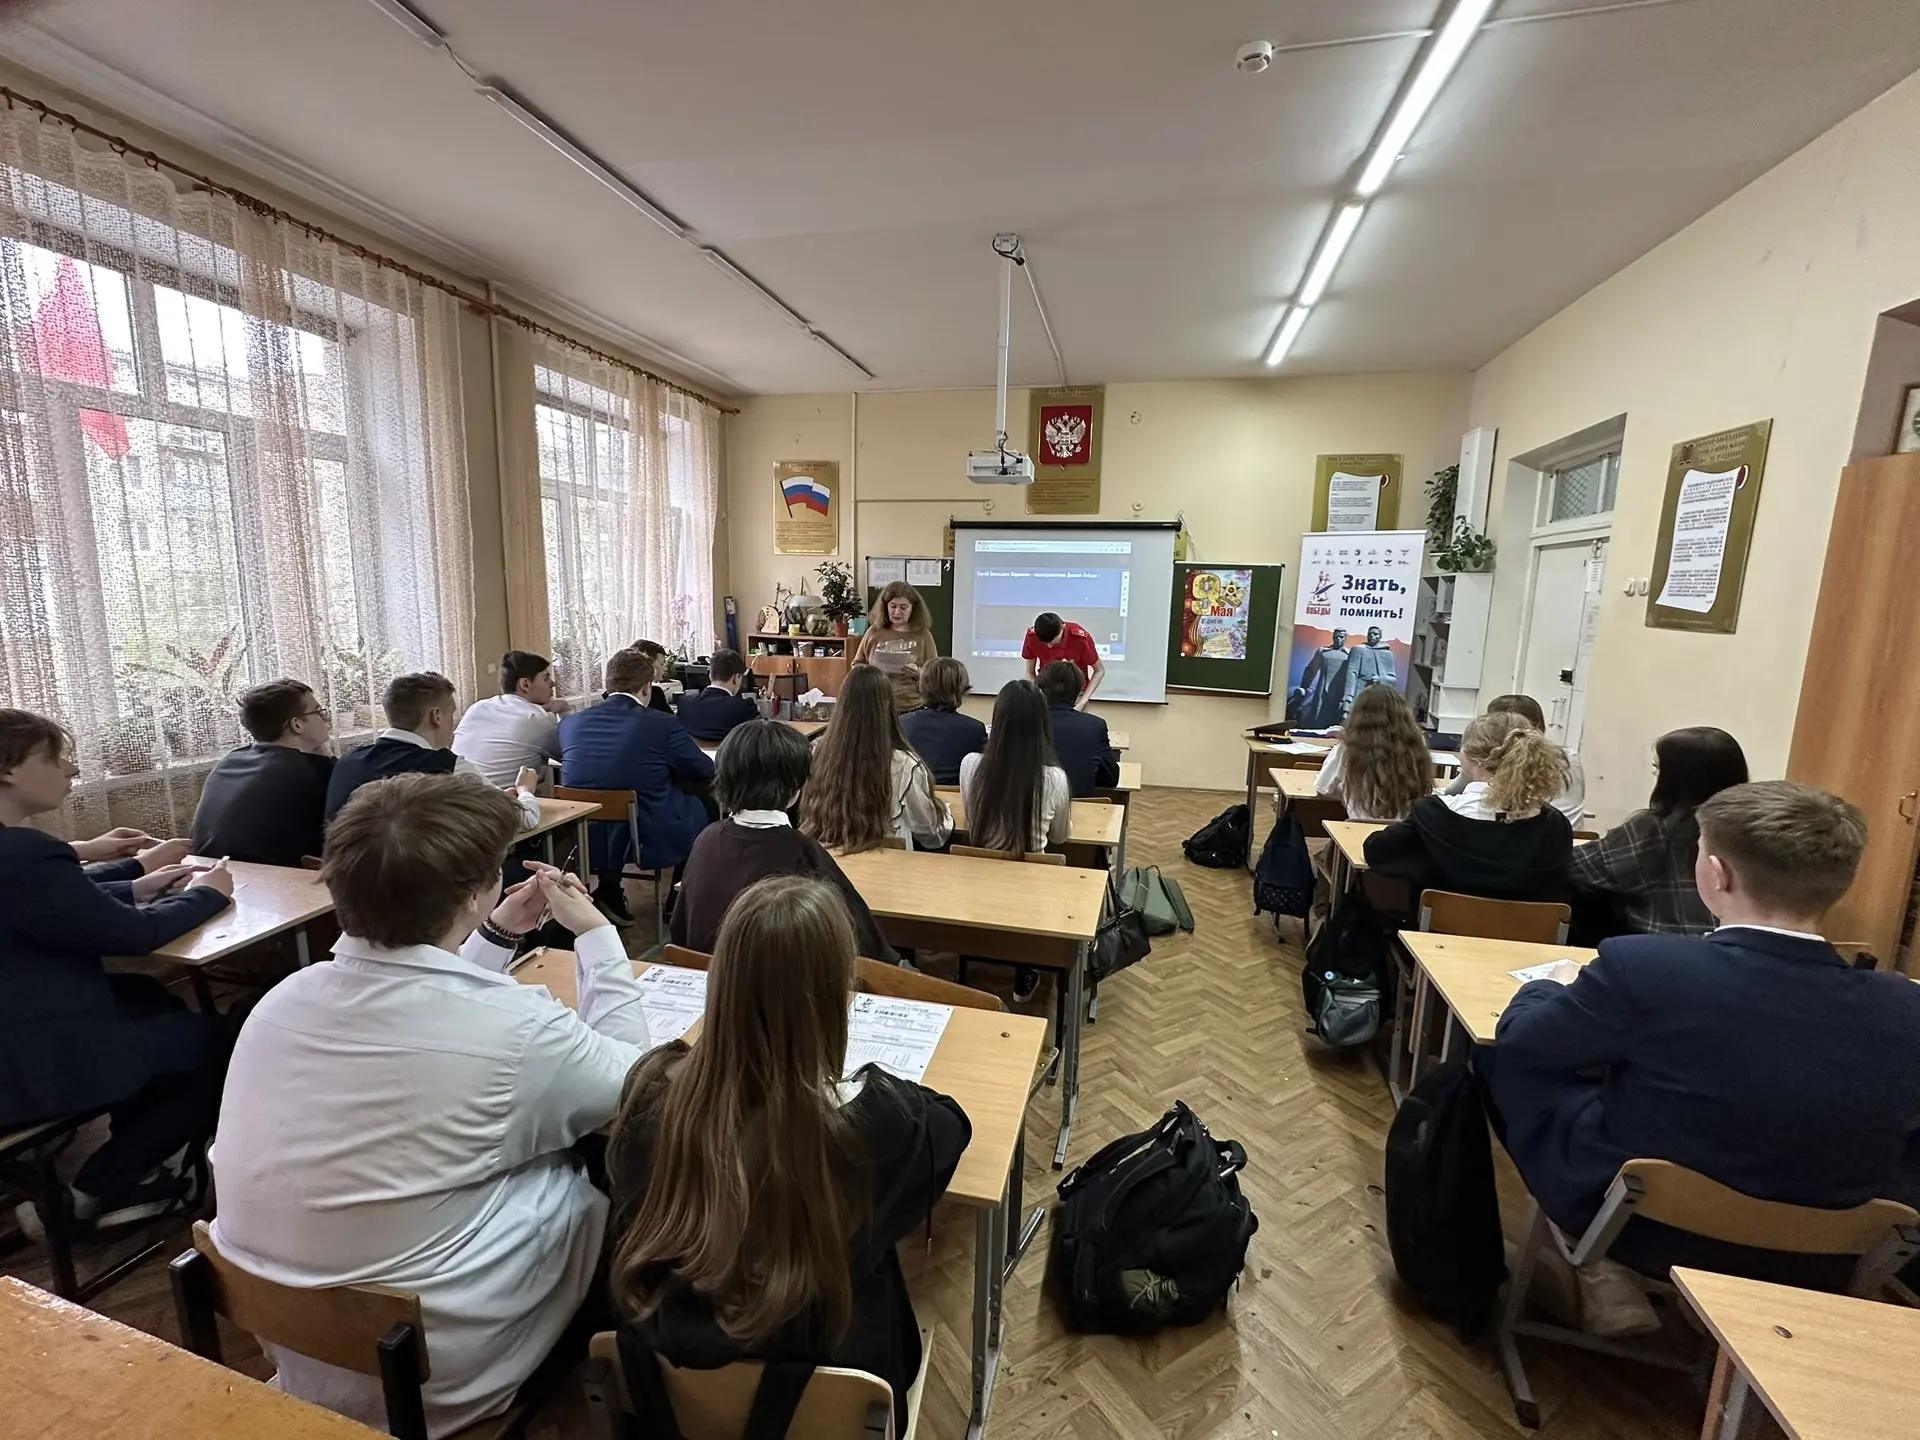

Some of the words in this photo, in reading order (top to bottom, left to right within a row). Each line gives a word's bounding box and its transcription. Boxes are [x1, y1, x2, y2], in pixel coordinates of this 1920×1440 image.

[1341, 574, 1406, 594] Знать,
[1191, 574, 1221, 615] 9
[1341, 593, 1383, 604] чтобы
[1306, 606, 1331, 616] ПОБЕДЫ
[1340, 607, 1403, 619] помнить!
